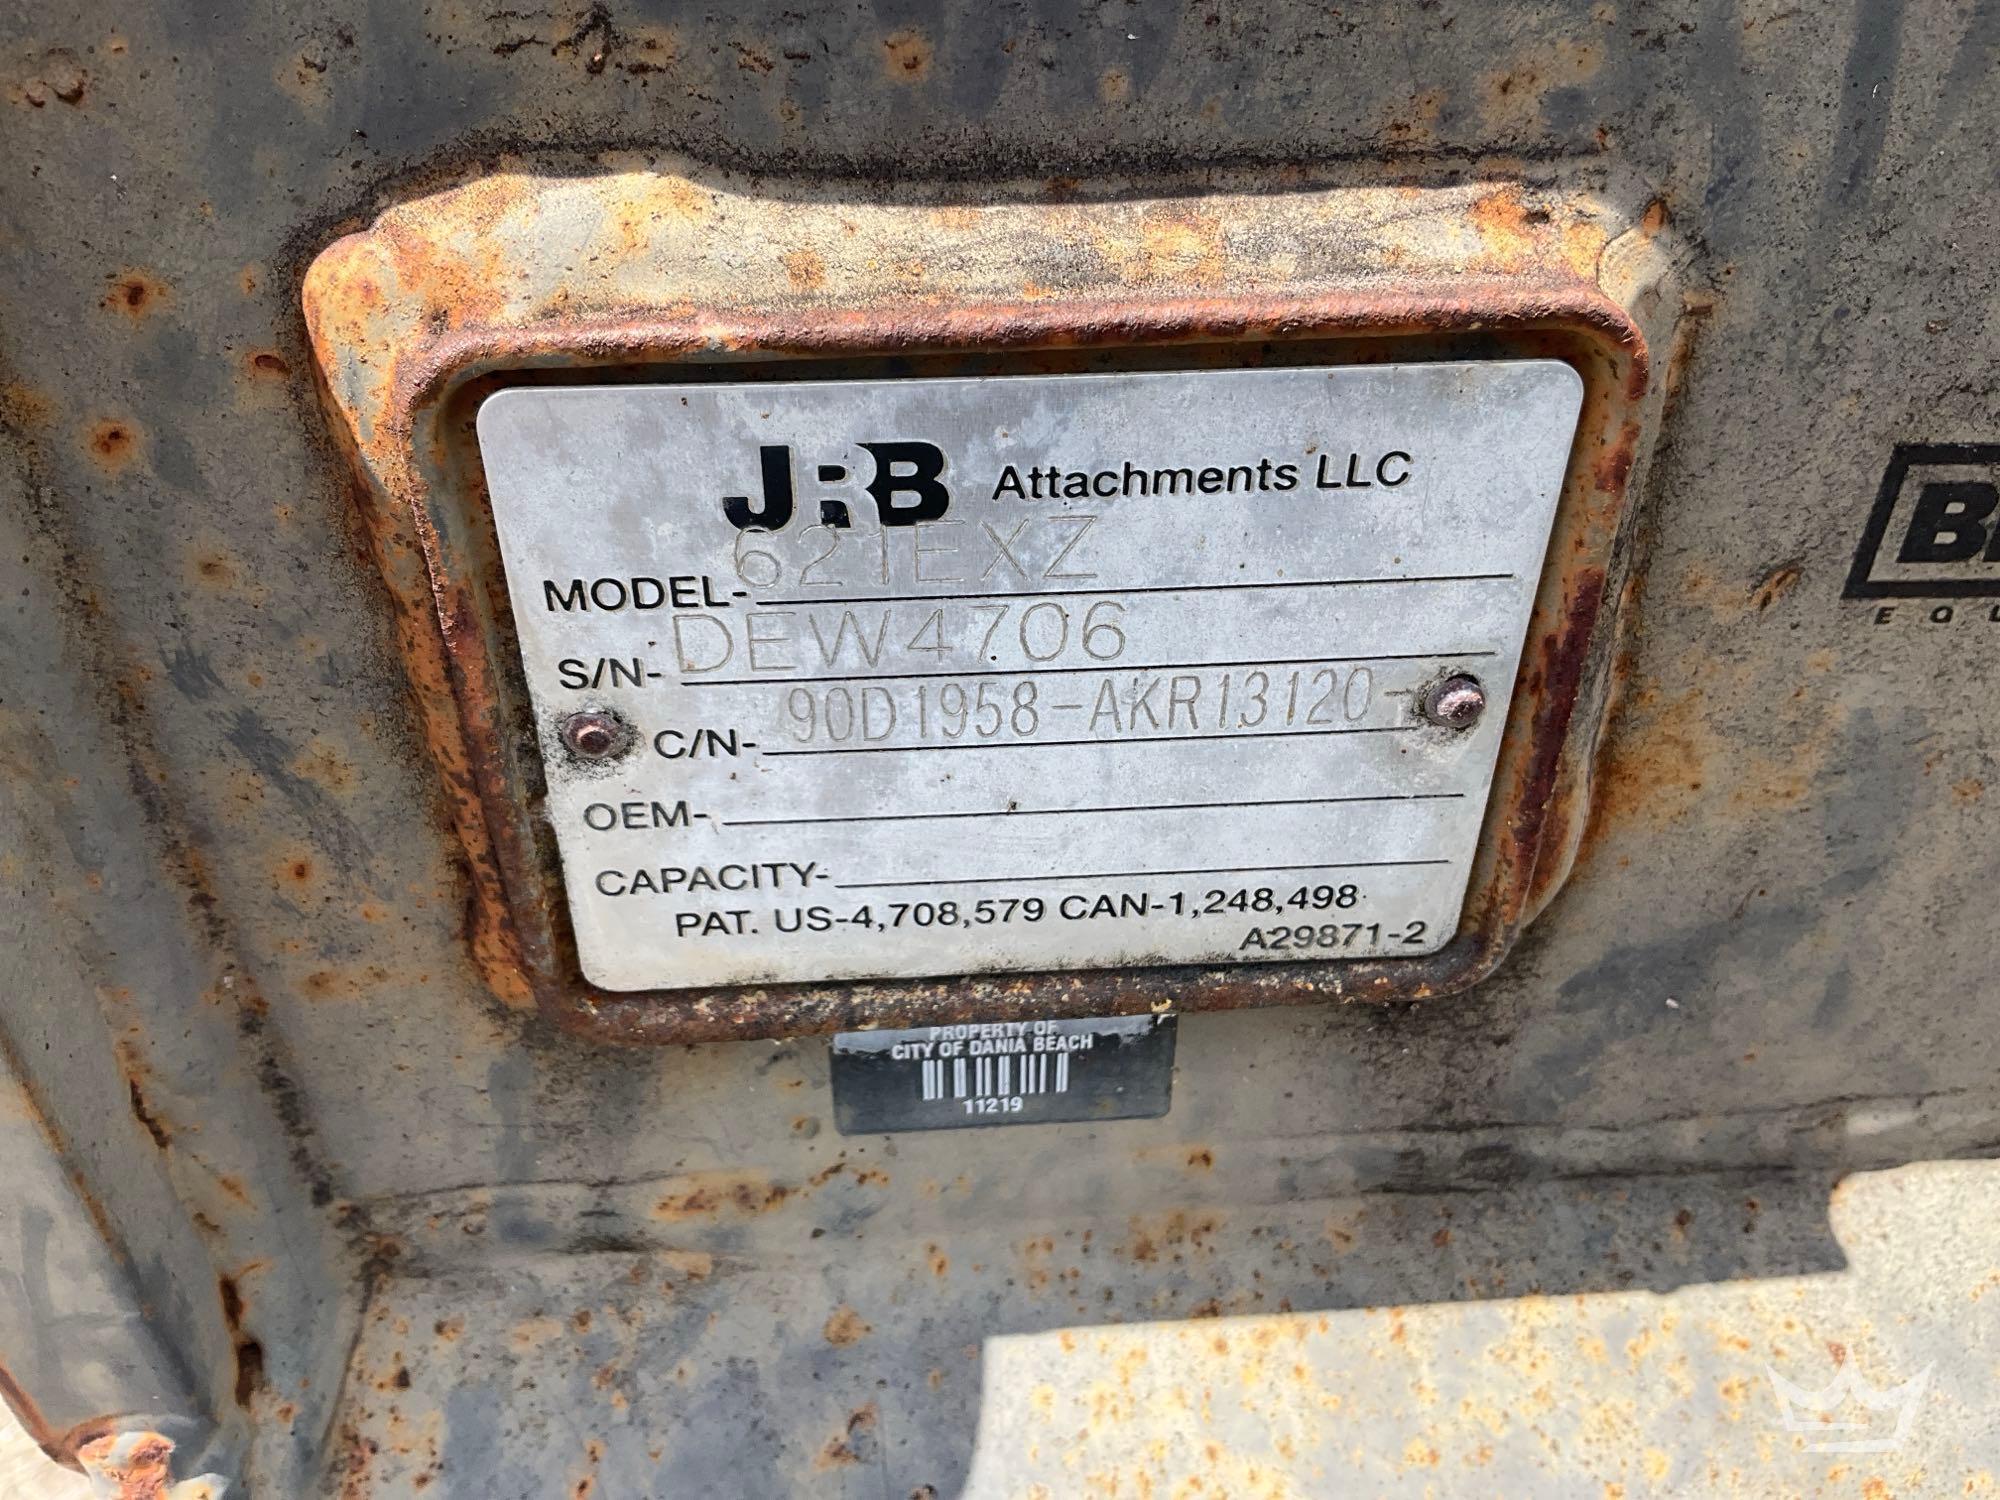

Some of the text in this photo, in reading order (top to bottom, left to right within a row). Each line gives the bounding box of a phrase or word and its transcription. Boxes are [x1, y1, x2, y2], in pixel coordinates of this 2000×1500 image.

[722, 440, 1412, 533] JRB Attachments LLC
[1896, 482, 2000, 563] B
[734, 515, 1098, 589] 621EXZ
[673, 601, 1126, 673] DEW4706
[676, 884, 1358, 937] PAT. US-4,708,579 CAN-1,248,498
[1239, 921, 1426, 950] A29871-2
[891, 1034, 1093, 1060] CITY OF DANIA BEACH
[930, 1020, 1058, 1041] PROPERTY OF
[963, 1097, 1024, 1115] 11219
